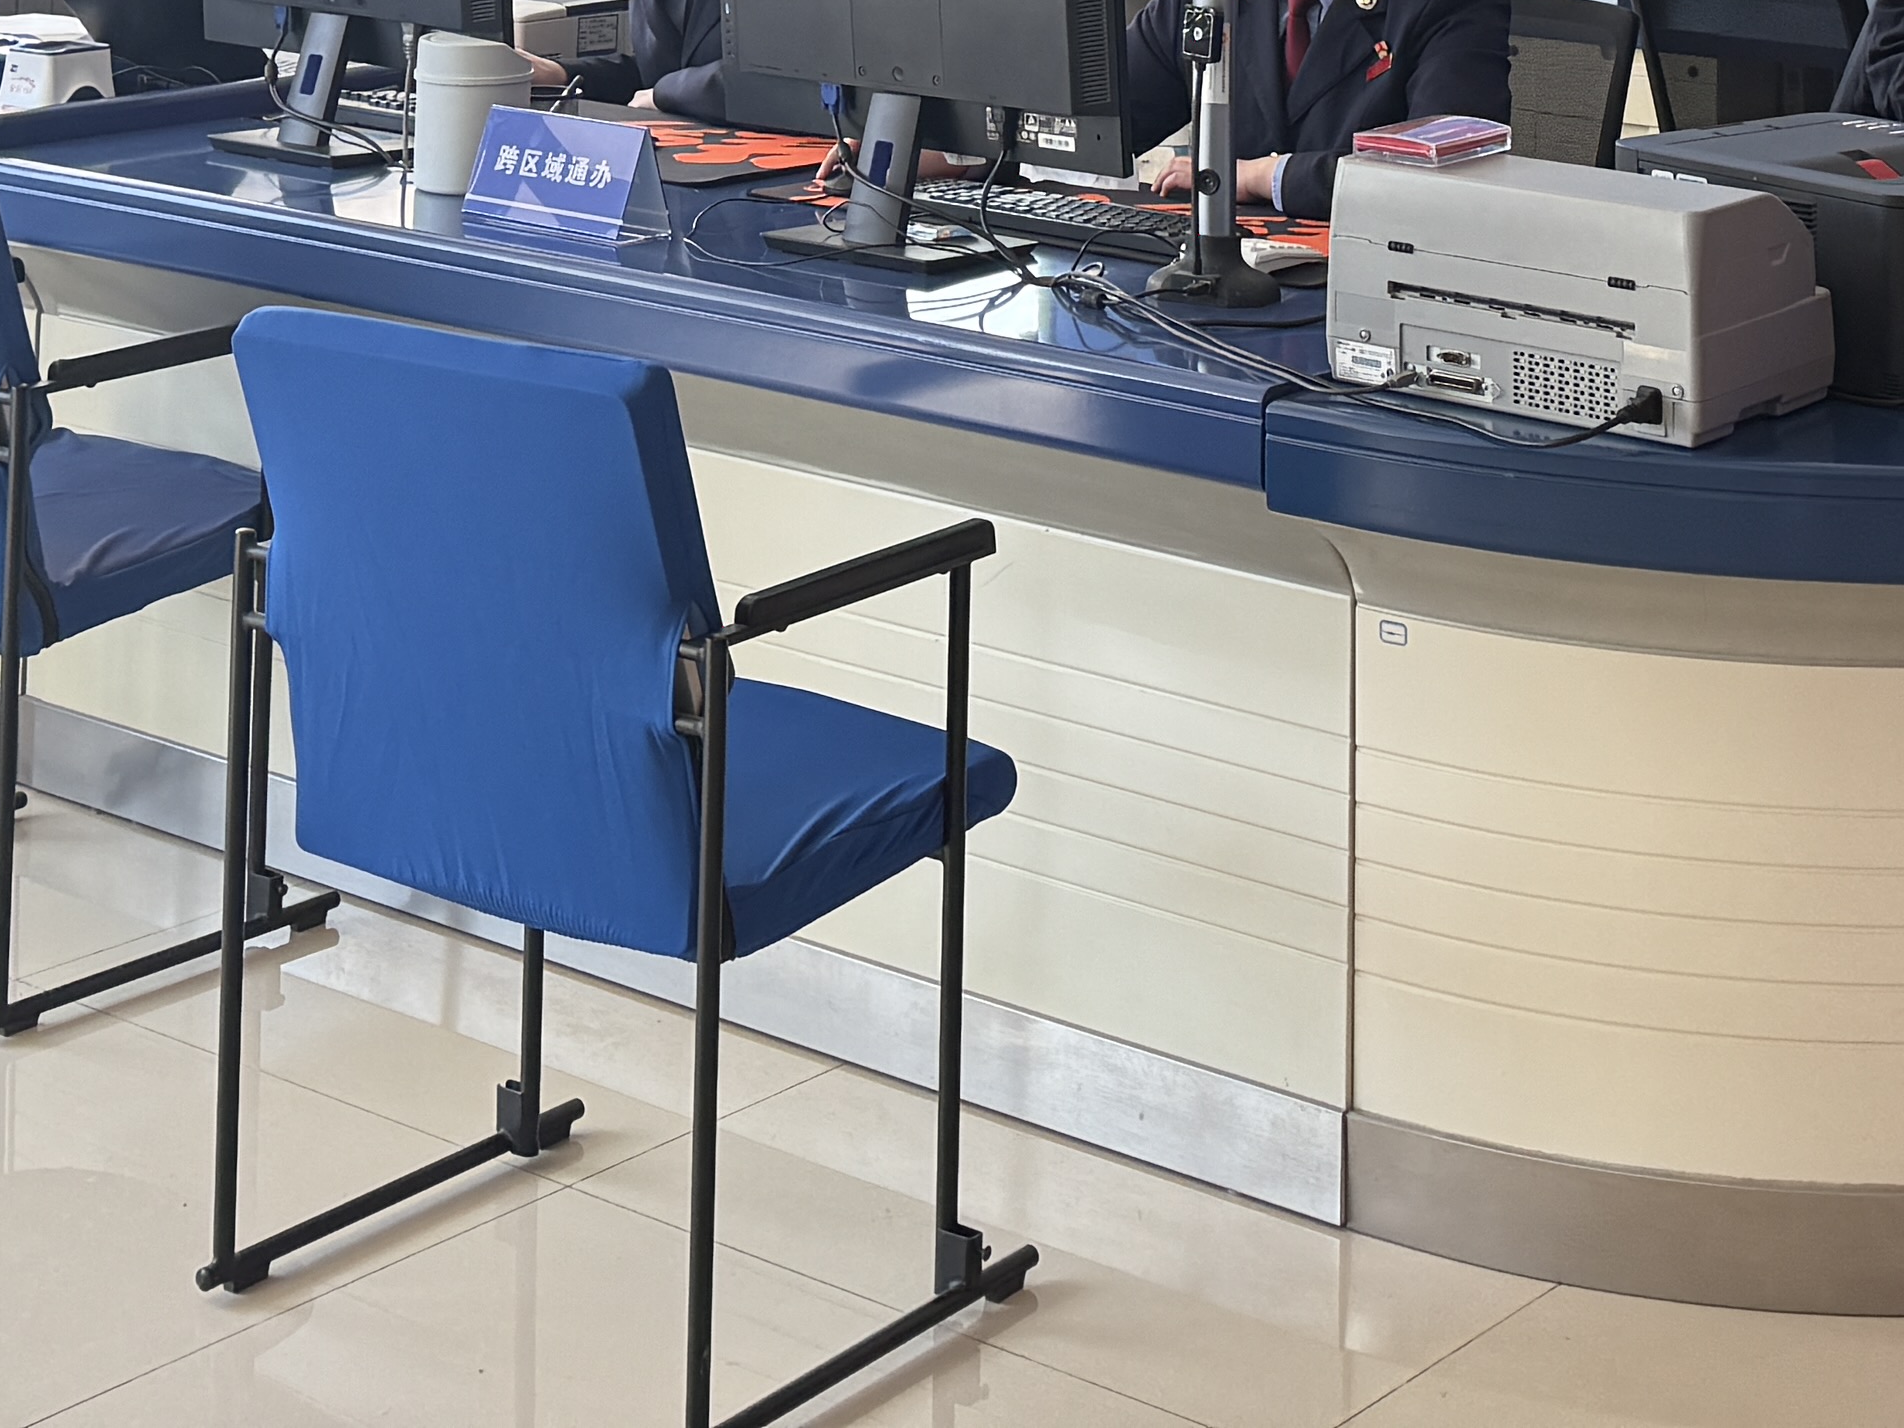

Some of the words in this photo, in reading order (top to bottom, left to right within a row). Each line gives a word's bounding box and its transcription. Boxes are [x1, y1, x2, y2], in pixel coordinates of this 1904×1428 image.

[493, 144, 612, 189] 跨区域通办
